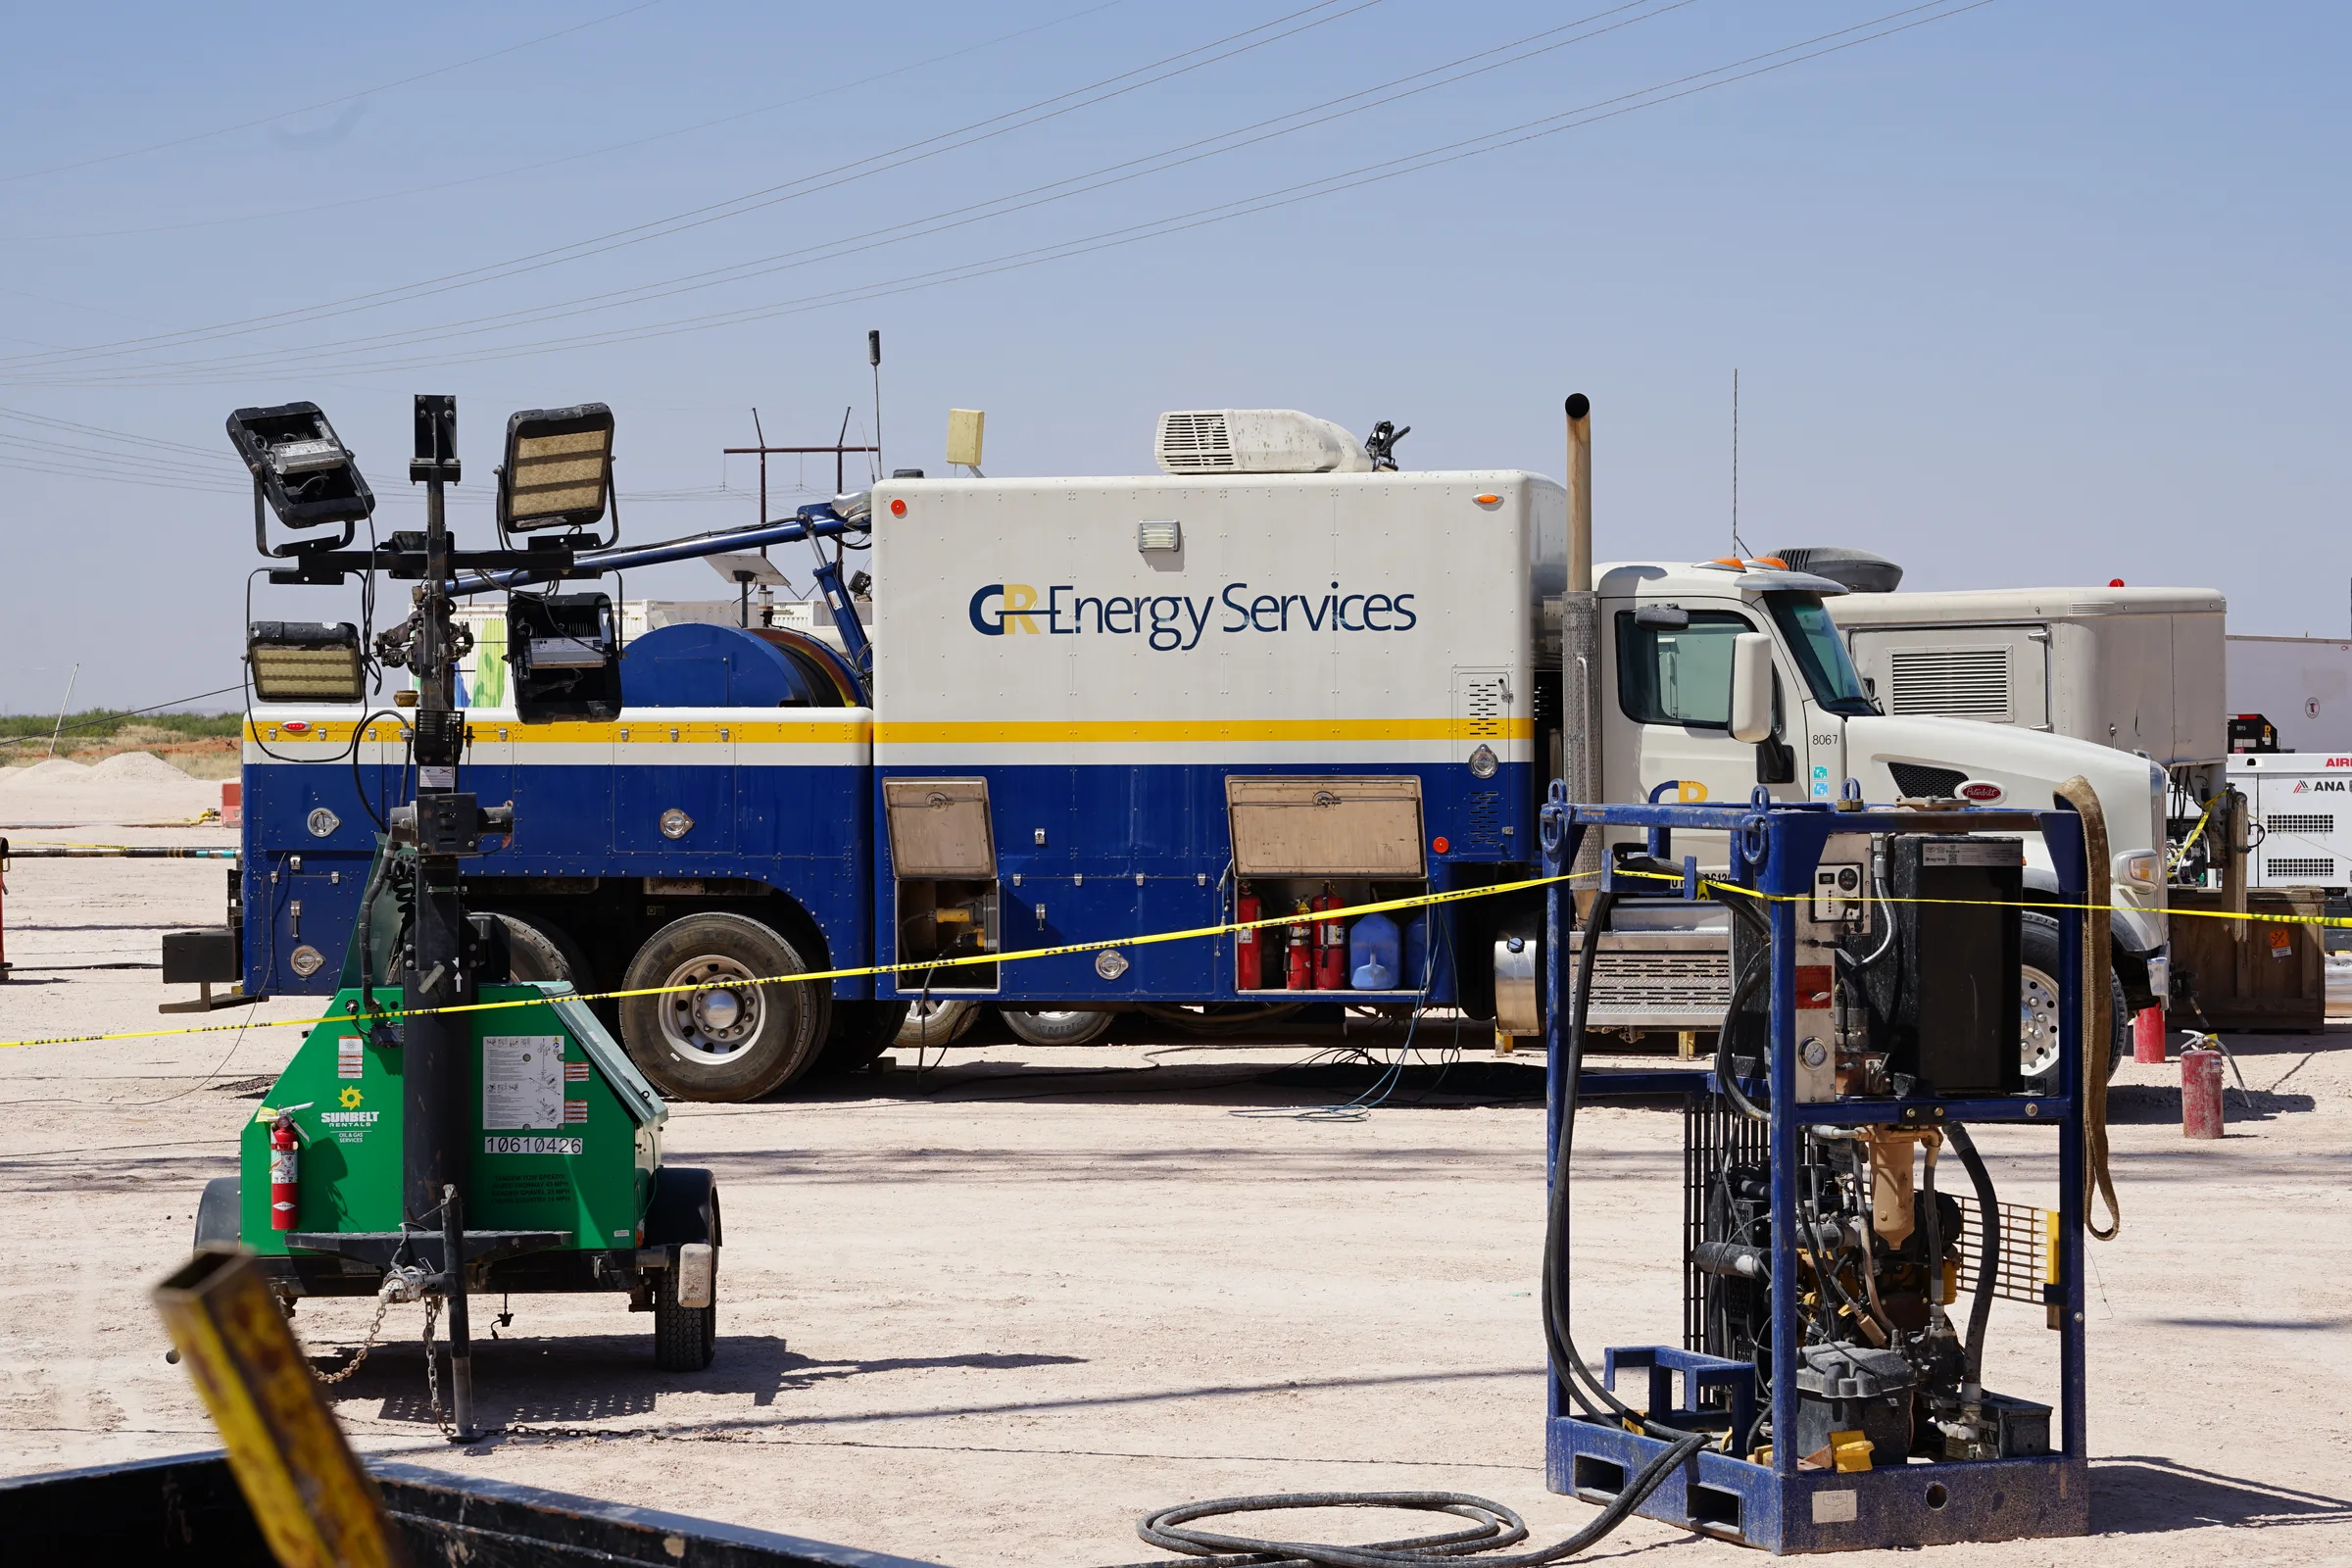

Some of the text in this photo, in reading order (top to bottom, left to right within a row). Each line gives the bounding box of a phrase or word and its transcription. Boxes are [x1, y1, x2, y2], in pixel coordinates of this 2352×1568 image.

[1050, 585, 1214, 651] Energy
[1222, 581, 1417, 632] Services
[1812, 734, 1838, 746] 8067
[2314, 781, 2345, 792] ANA
[320, 1111, 380, 1123] SUNBELT
[487, 1137, 581, 1153] 10610426
